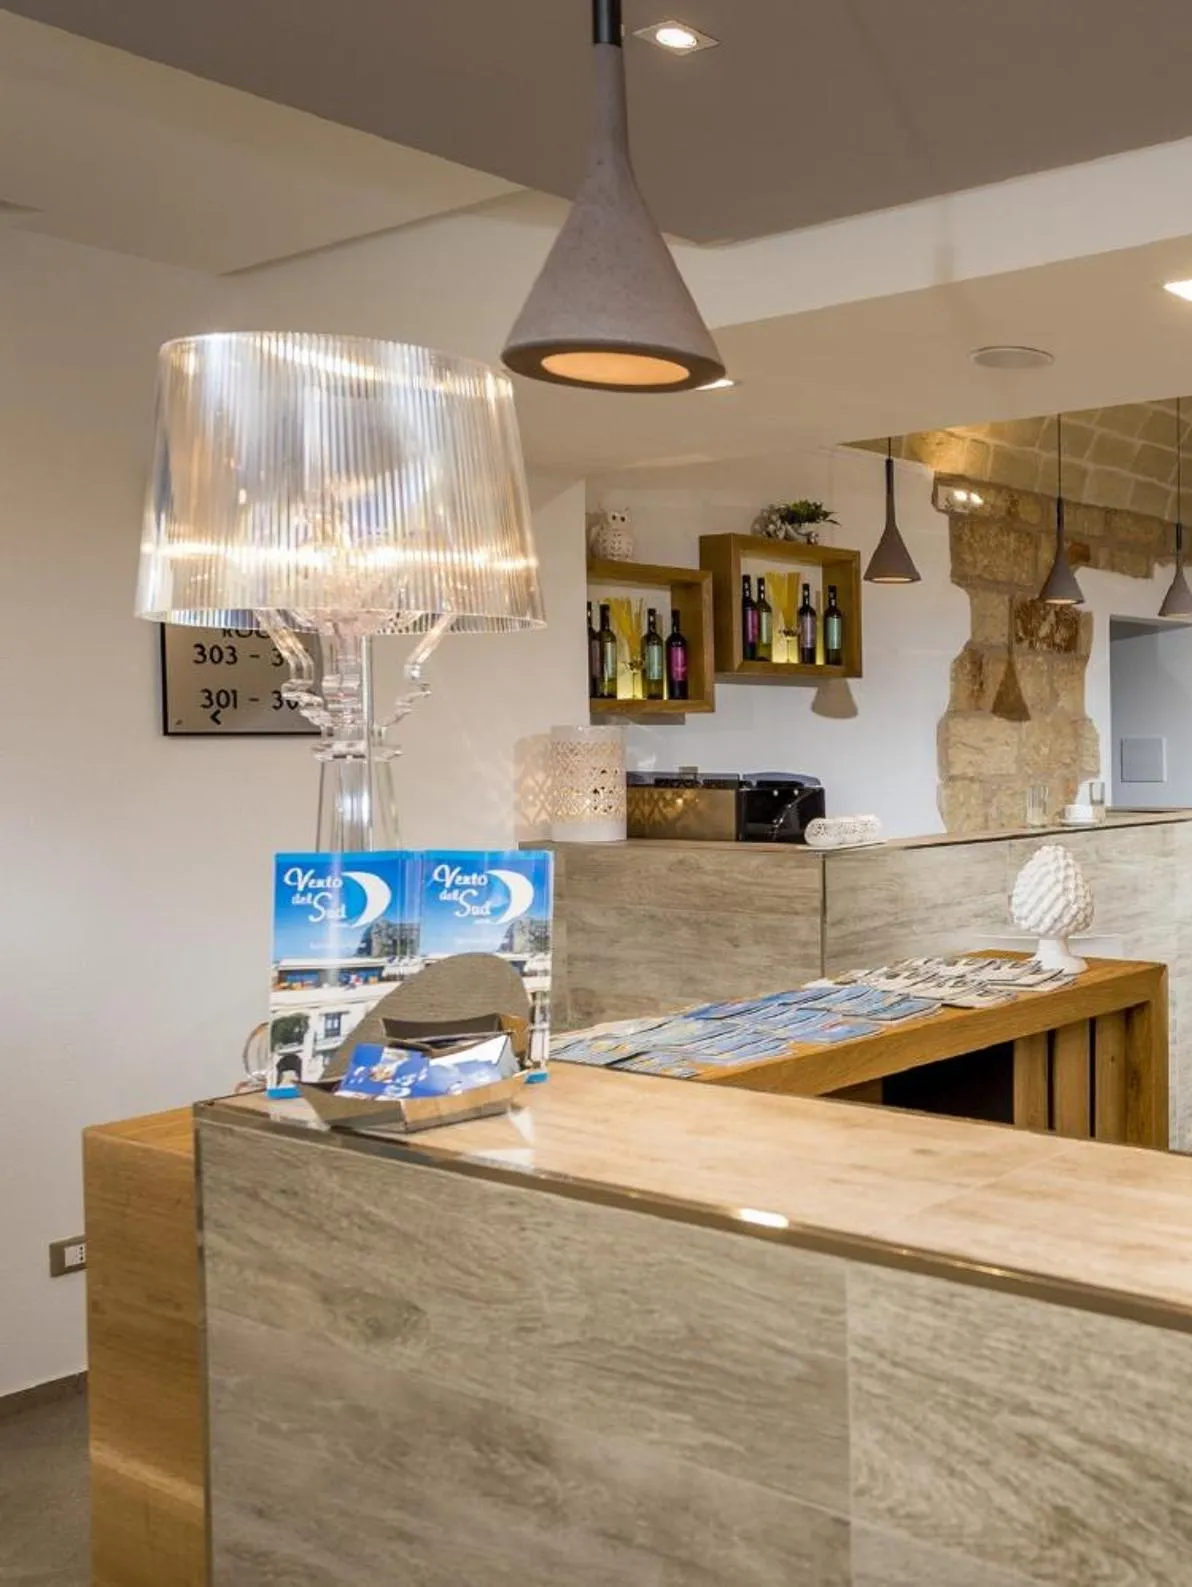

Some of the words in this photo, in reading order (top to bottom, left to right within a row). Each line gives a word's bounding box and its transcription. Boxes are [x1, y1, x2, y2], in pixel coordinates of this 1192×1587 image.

[193, 644, 238, 665] 303
[200, 688, 238, 710] 301
[283, 866, 344, 891] Vento
[432, 864, 489, 888] Vento
[455, 888, 492, 917] Sud
